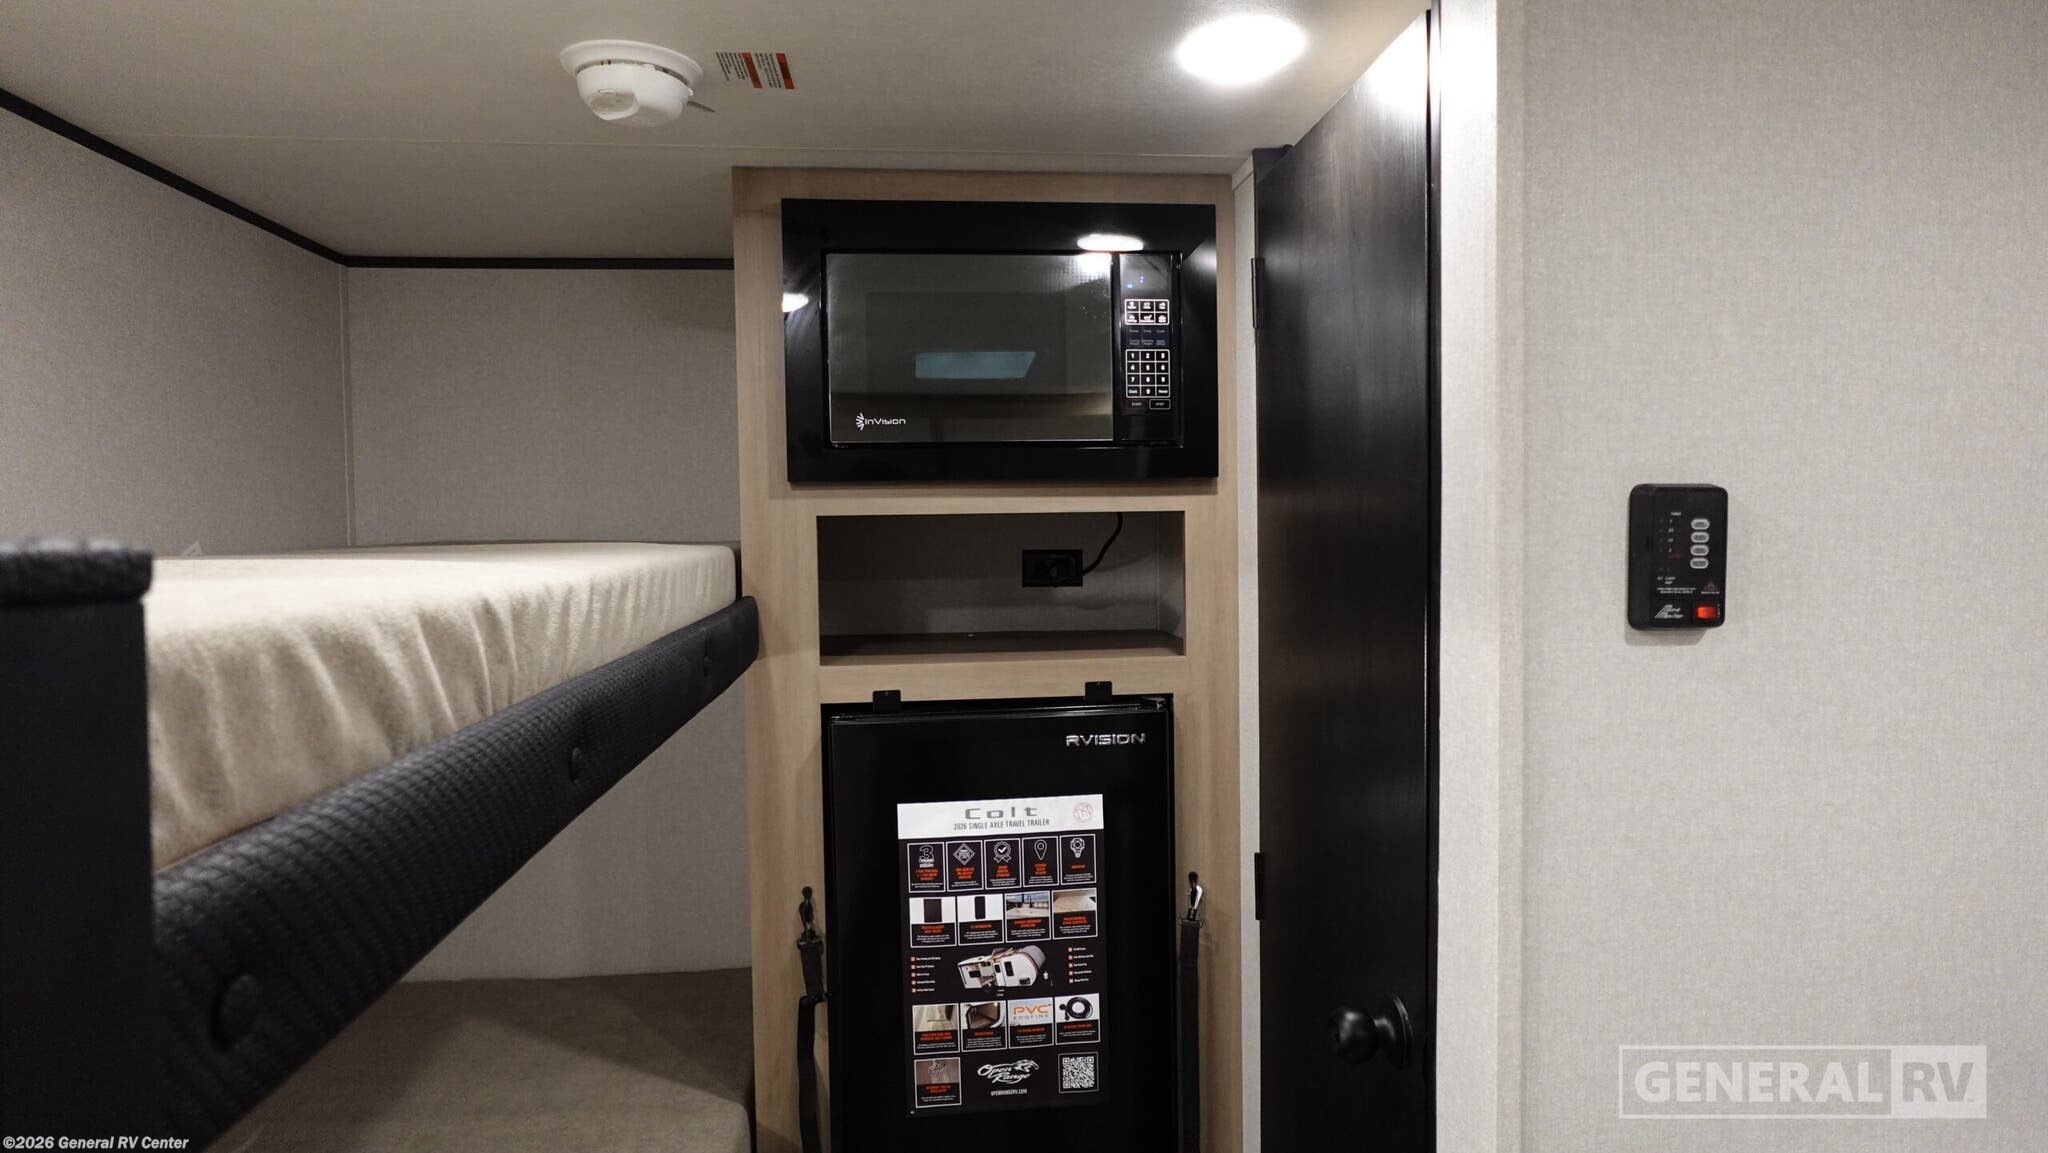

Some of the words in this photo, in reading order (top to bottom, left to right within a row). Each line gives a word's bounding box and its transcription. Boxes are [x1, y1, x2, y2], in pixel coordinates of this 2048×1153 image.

[1066, 733, 1146, 746] RVISION
[965, 806, 1038, 820] Colt
[1013, 1004, 1048, 1015] PVC
[978, 1064, 1012, 1078] Open
[990, 1072, 1030, 1084] Range
